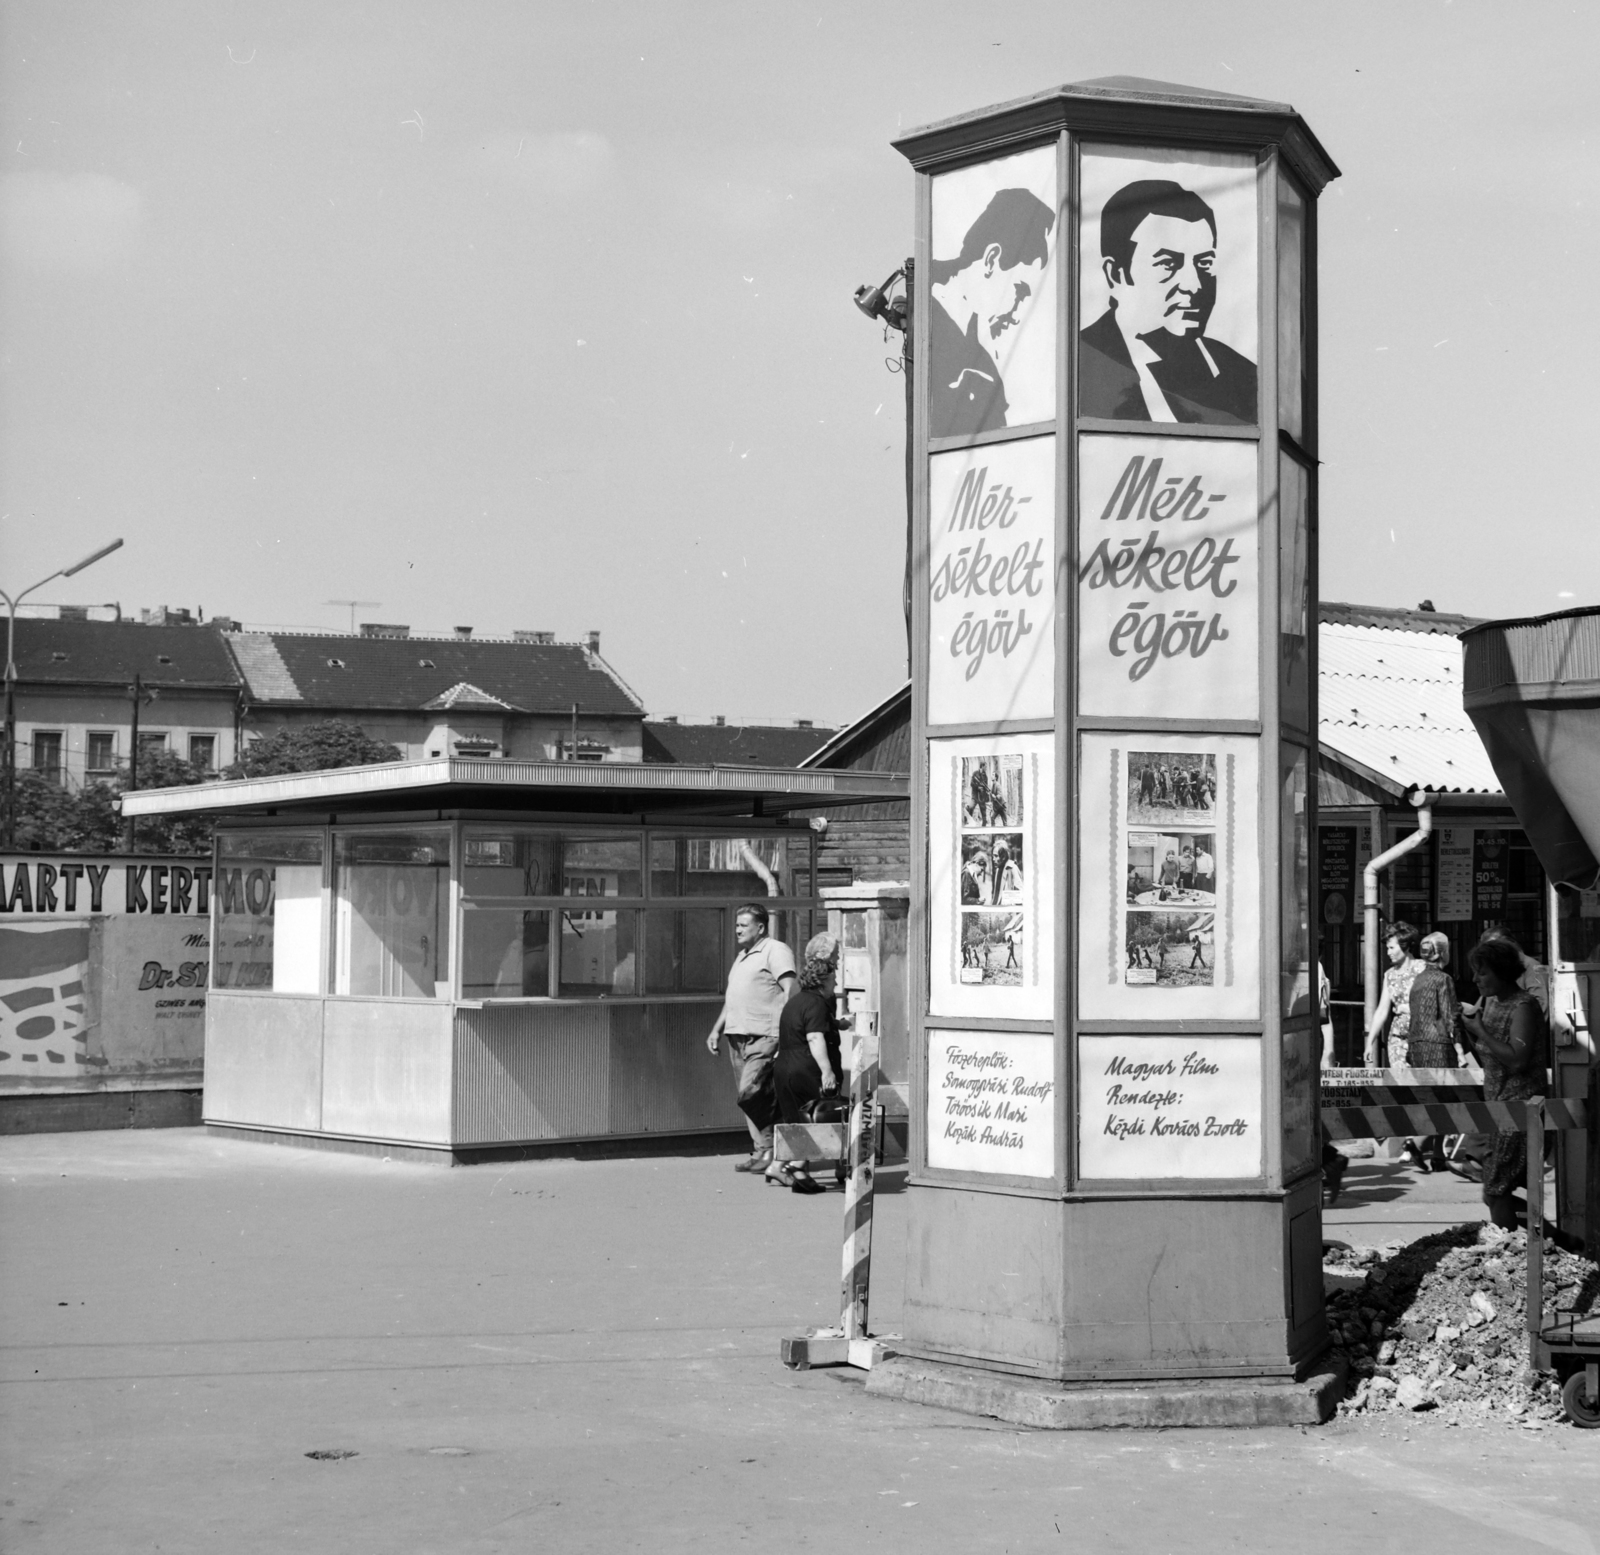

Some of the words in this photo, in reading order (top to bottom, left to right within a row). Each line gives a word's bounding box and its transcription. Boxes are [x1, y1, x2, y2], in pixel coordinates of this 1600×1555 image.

[930, 537, 1045, 602] sékelt
[1079, 530, 1241, 598] sékelt
[949, 608, 1033, 682] égöv
[1108, 601, 1229, 683] égöv
[1104, 1055, 1176, 1081] Magyar
[1150, 1116, 1200, 1137] Kovács
[1203, 1116, 1249, 1137] Zsolt
